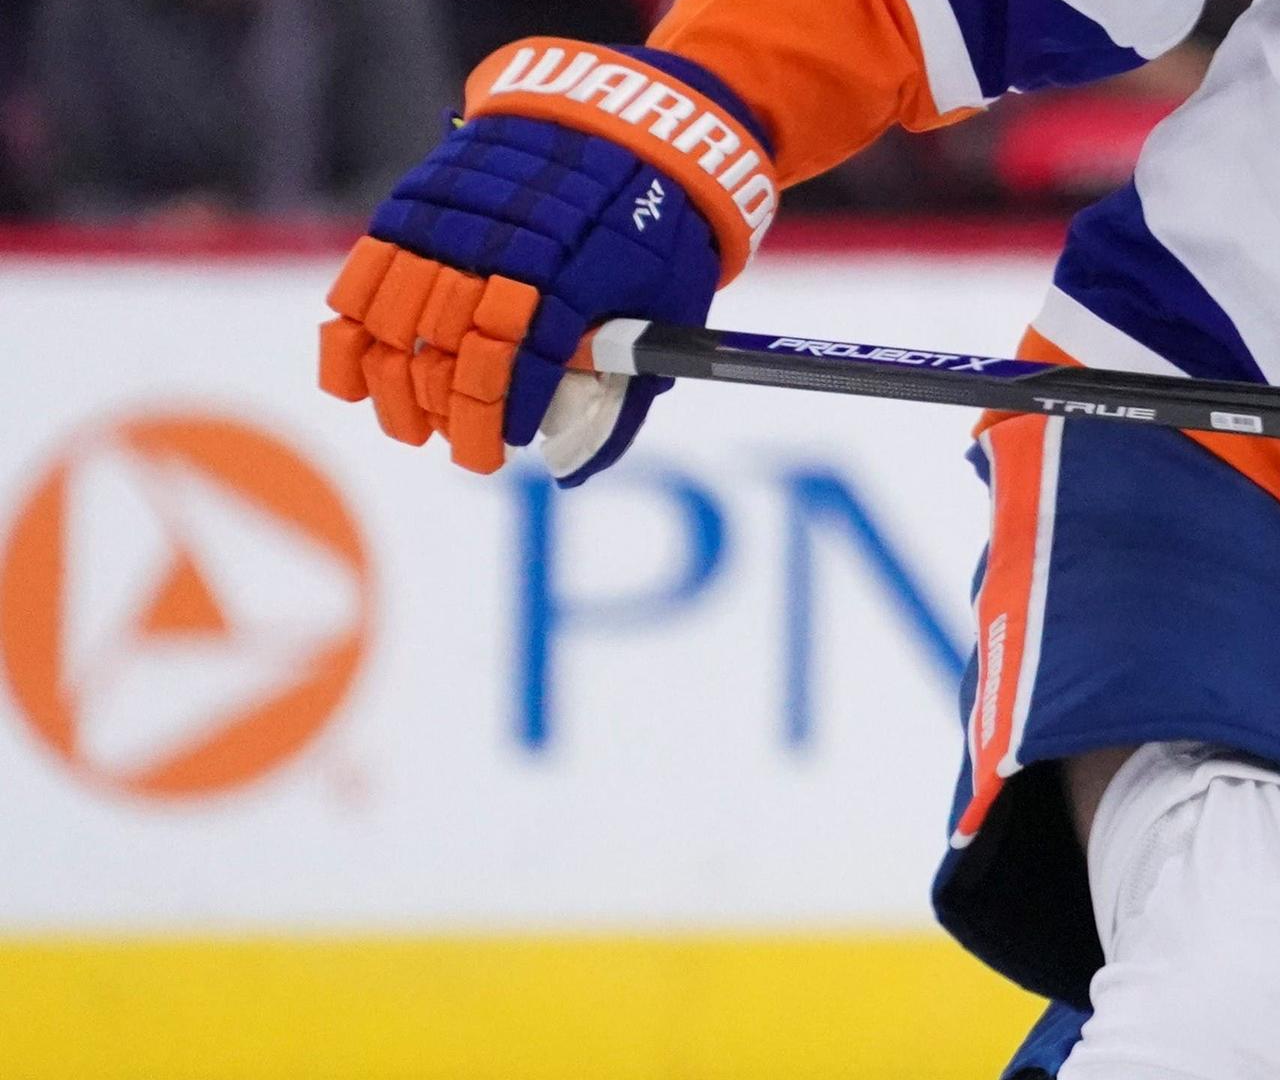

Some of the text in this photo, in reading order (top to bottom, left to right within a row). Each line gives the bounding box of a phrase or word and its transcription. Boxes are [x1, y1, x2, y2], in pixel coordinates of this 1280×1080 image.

[767, 337, 1003, 371] PROJECT X
[1033, 397, 1156, 420] TRUE
